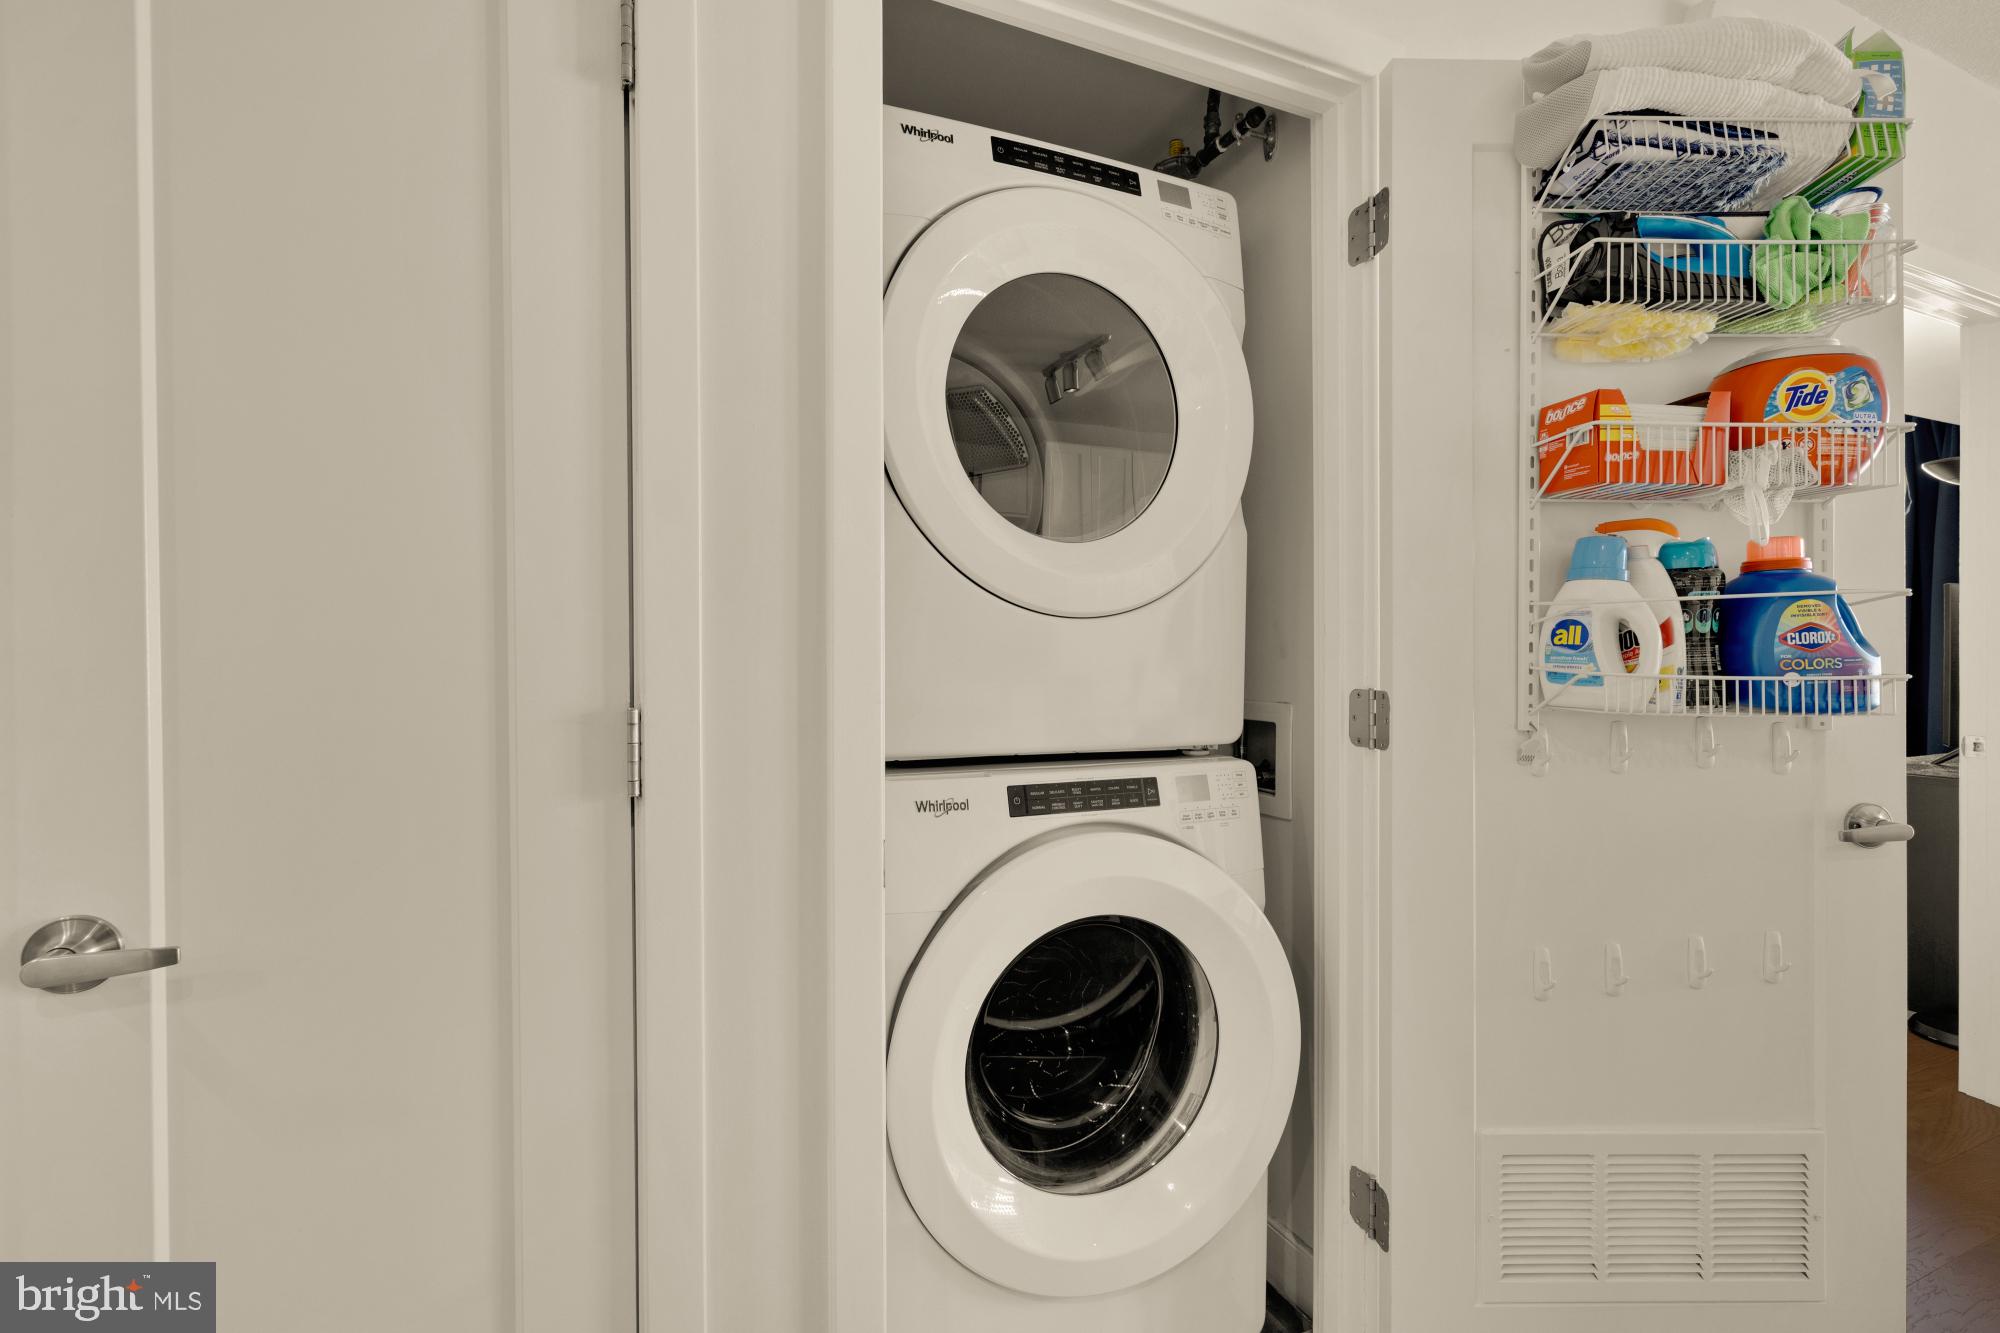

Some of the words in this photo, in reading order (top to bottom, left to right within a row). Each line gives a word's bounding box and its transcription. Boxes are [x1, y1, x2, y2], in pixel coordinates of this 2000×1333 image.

[901, 123, 954, 144] Whirlpool
[1784, 384, 1828, 413] Tide
[1545, 397, 1587, 425] bounce
[1553, 625, 1583, 645] all
[1780, 658, 1843, 671] COLORS
[915, 799, 969, 815] Whirlpool
